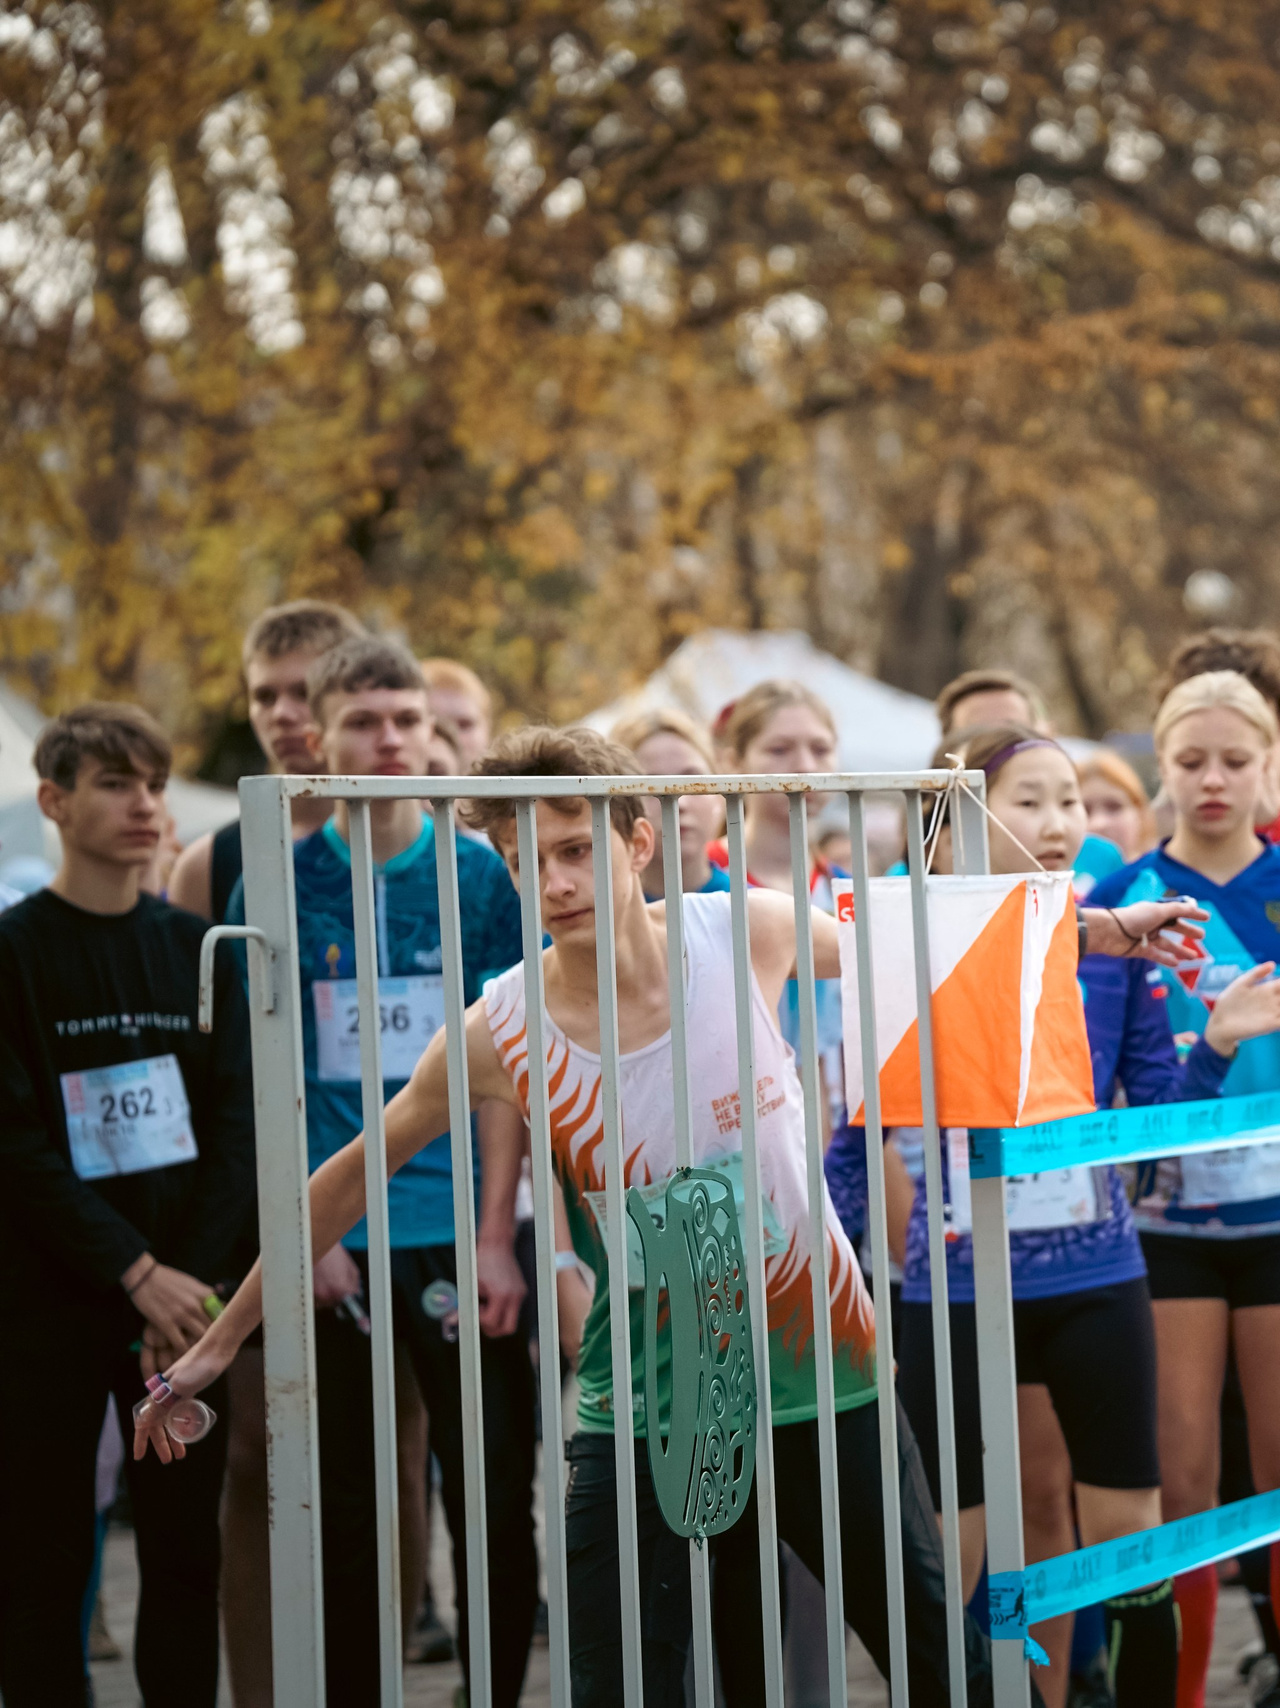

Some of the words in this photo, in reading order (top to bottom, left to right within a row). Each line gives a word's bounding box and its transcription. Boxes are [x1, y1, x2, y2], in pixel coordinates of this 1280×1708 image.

[55, 1013, 118, 1036] TOMMY
[100, 1086, 156, 1123] 262
[711, 1090, 740, 1111] ВИЖ
